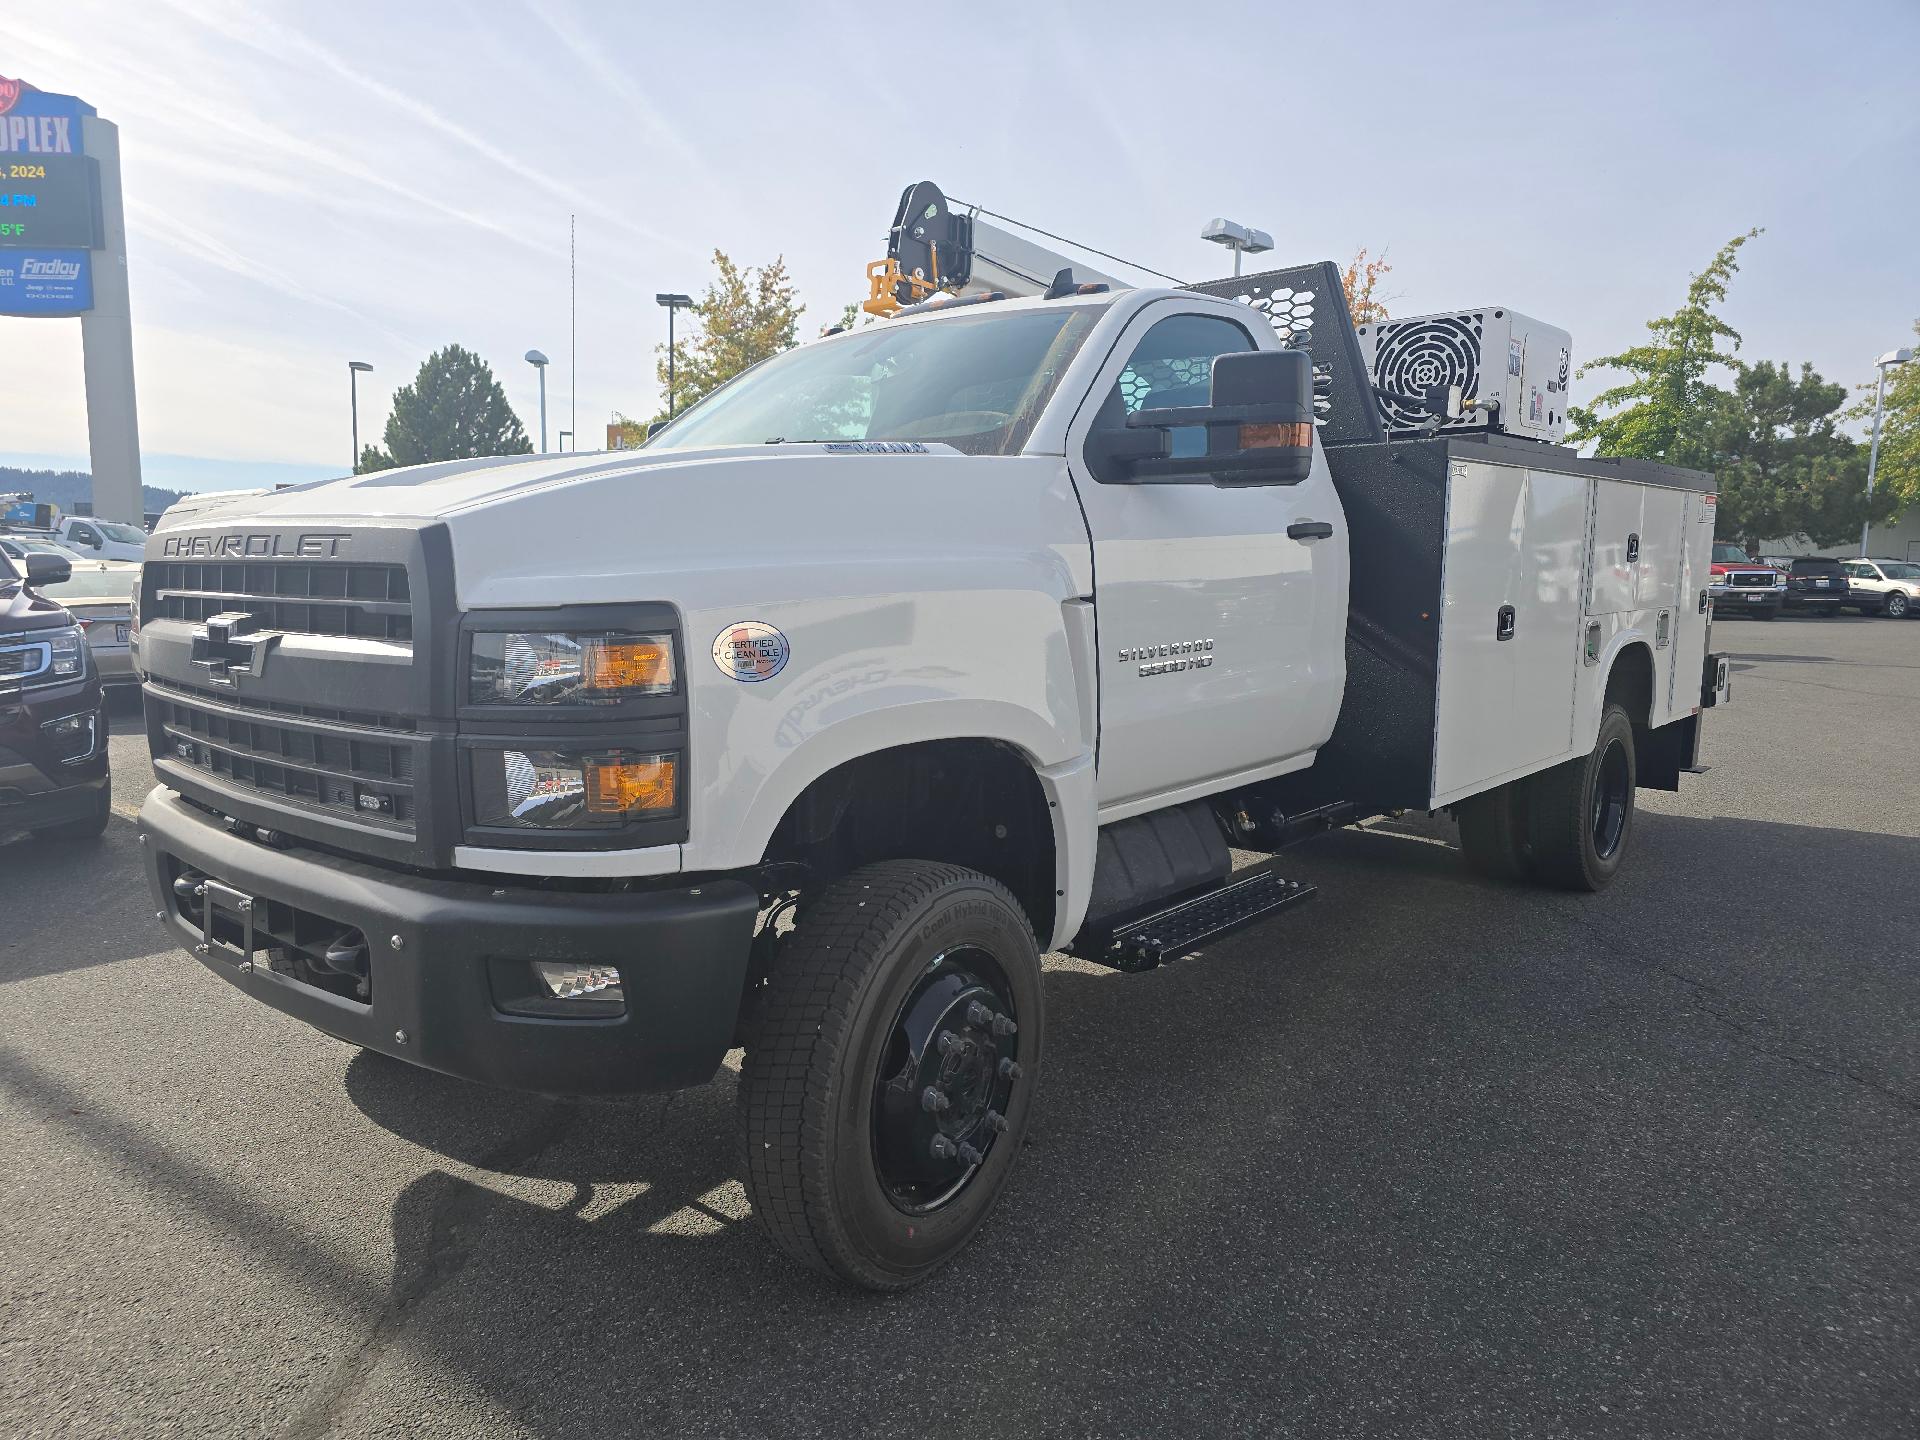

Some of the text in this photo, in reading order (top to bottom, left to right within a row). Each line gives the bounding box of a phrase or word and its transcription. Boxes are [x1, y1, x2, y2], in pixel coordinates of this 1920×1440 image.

[10, 165, 46, 178] 2024
[13, 194, 37, 207] PM
[20, 258, 81, 280] Findlay
[163, 533, 353, 558] CHEVROLET
[727, 639, 774, 649] CERTIFIED
[1118, 638, 1214, 662] SILVERADO
[724, 648, 780, 660] CLEAN IDLE
